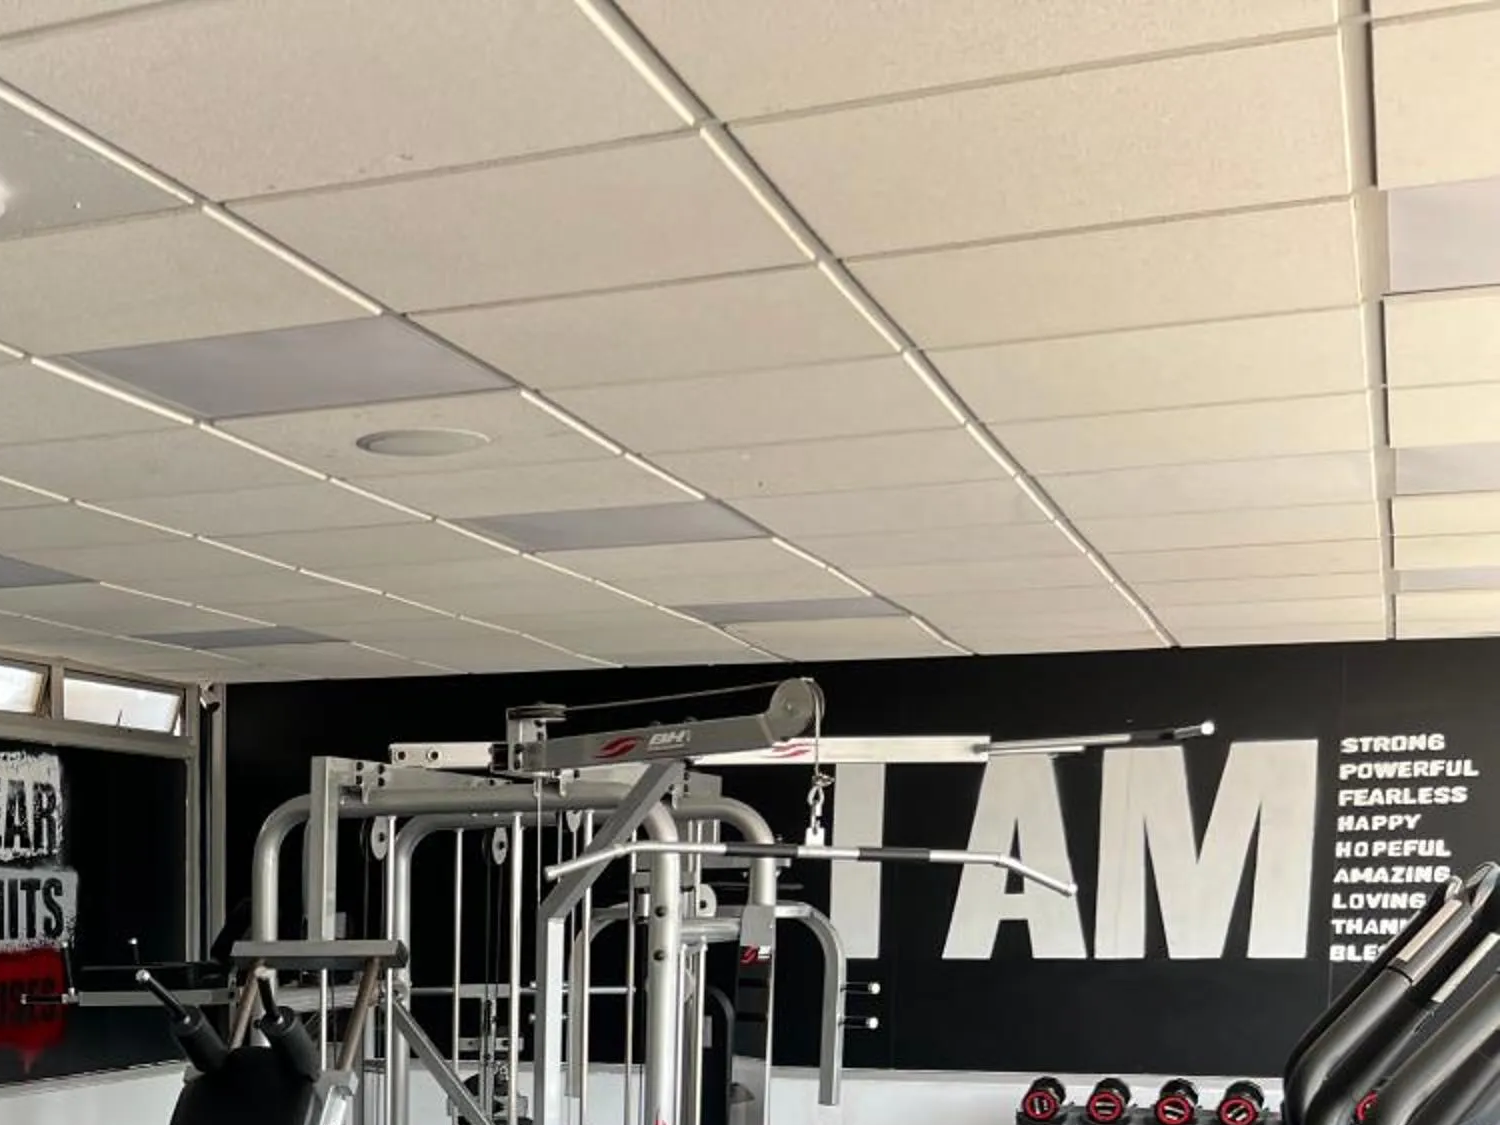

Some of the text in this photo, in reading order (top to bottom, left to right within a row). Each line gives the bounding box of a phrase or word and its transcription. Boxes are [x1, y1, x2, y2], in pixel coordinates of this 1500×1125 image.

[1340, 733, 1446, 754] STRONG
[1338, 759, 1480, 781] POWERFUL
[1337, 786, 1468, 807] FEARLESS
[1337, 814, 1422, 833] HAPPY
[942, 740, 1319, 960] AM
[1335, 839, 1452, 859] HOPEFUL
[1333, 865, 1451, 884] AMAZING
[1331, 892, 1427, 910] LOVING
